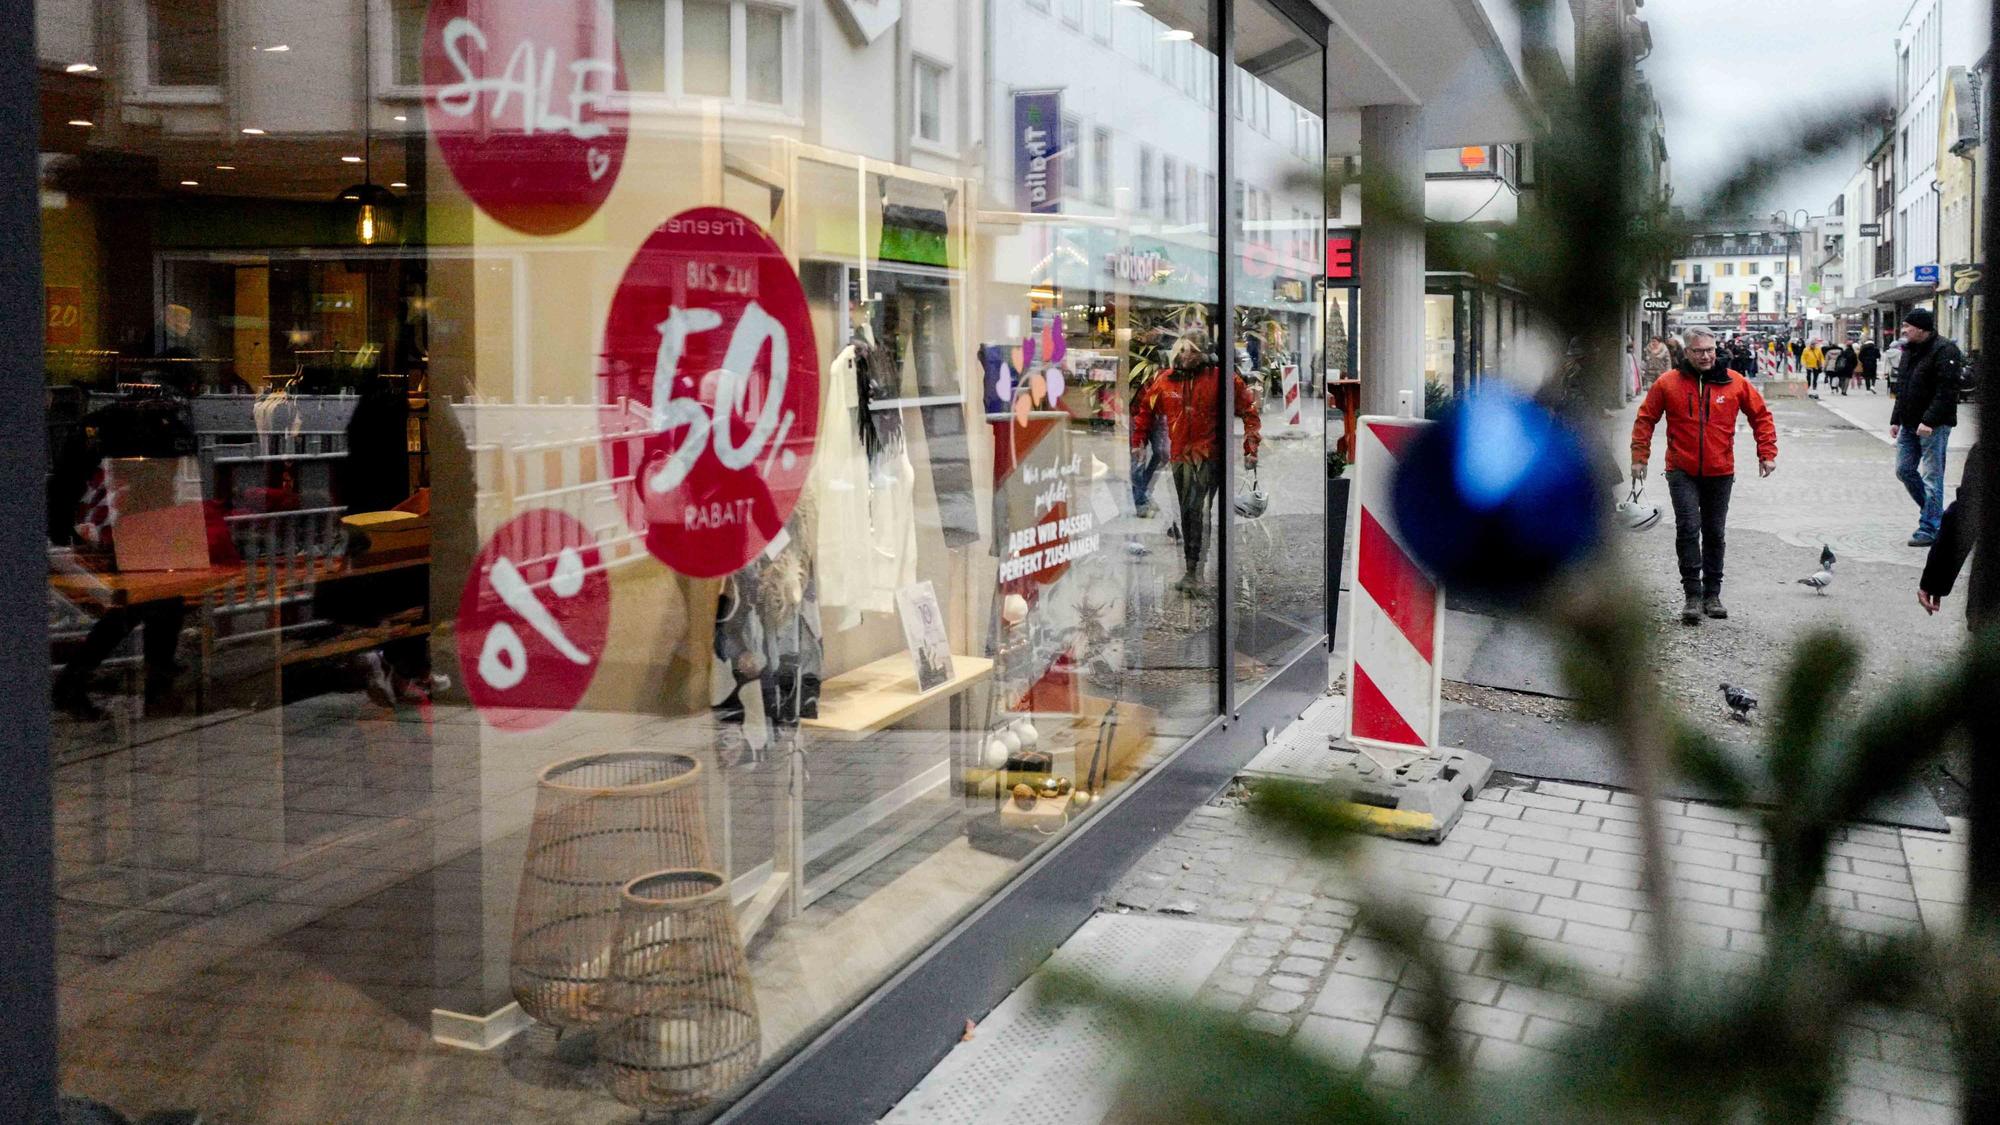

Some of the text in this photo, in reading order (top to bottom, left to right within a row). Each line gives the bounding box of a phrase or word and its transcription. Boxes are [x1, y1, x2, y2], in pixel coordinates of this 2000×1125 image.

[437, 17, 616, 139] SALE
[687, 261, 752, 294] BIS ZU
[48, 304, 78, 327] 20
[684, 498, 755, 531] RABATT
[1008, 512, 1092, 554] ABER WIR PASSEN
[999, 533, 1100, 583] PERFEKT ZUSAMMEN!
